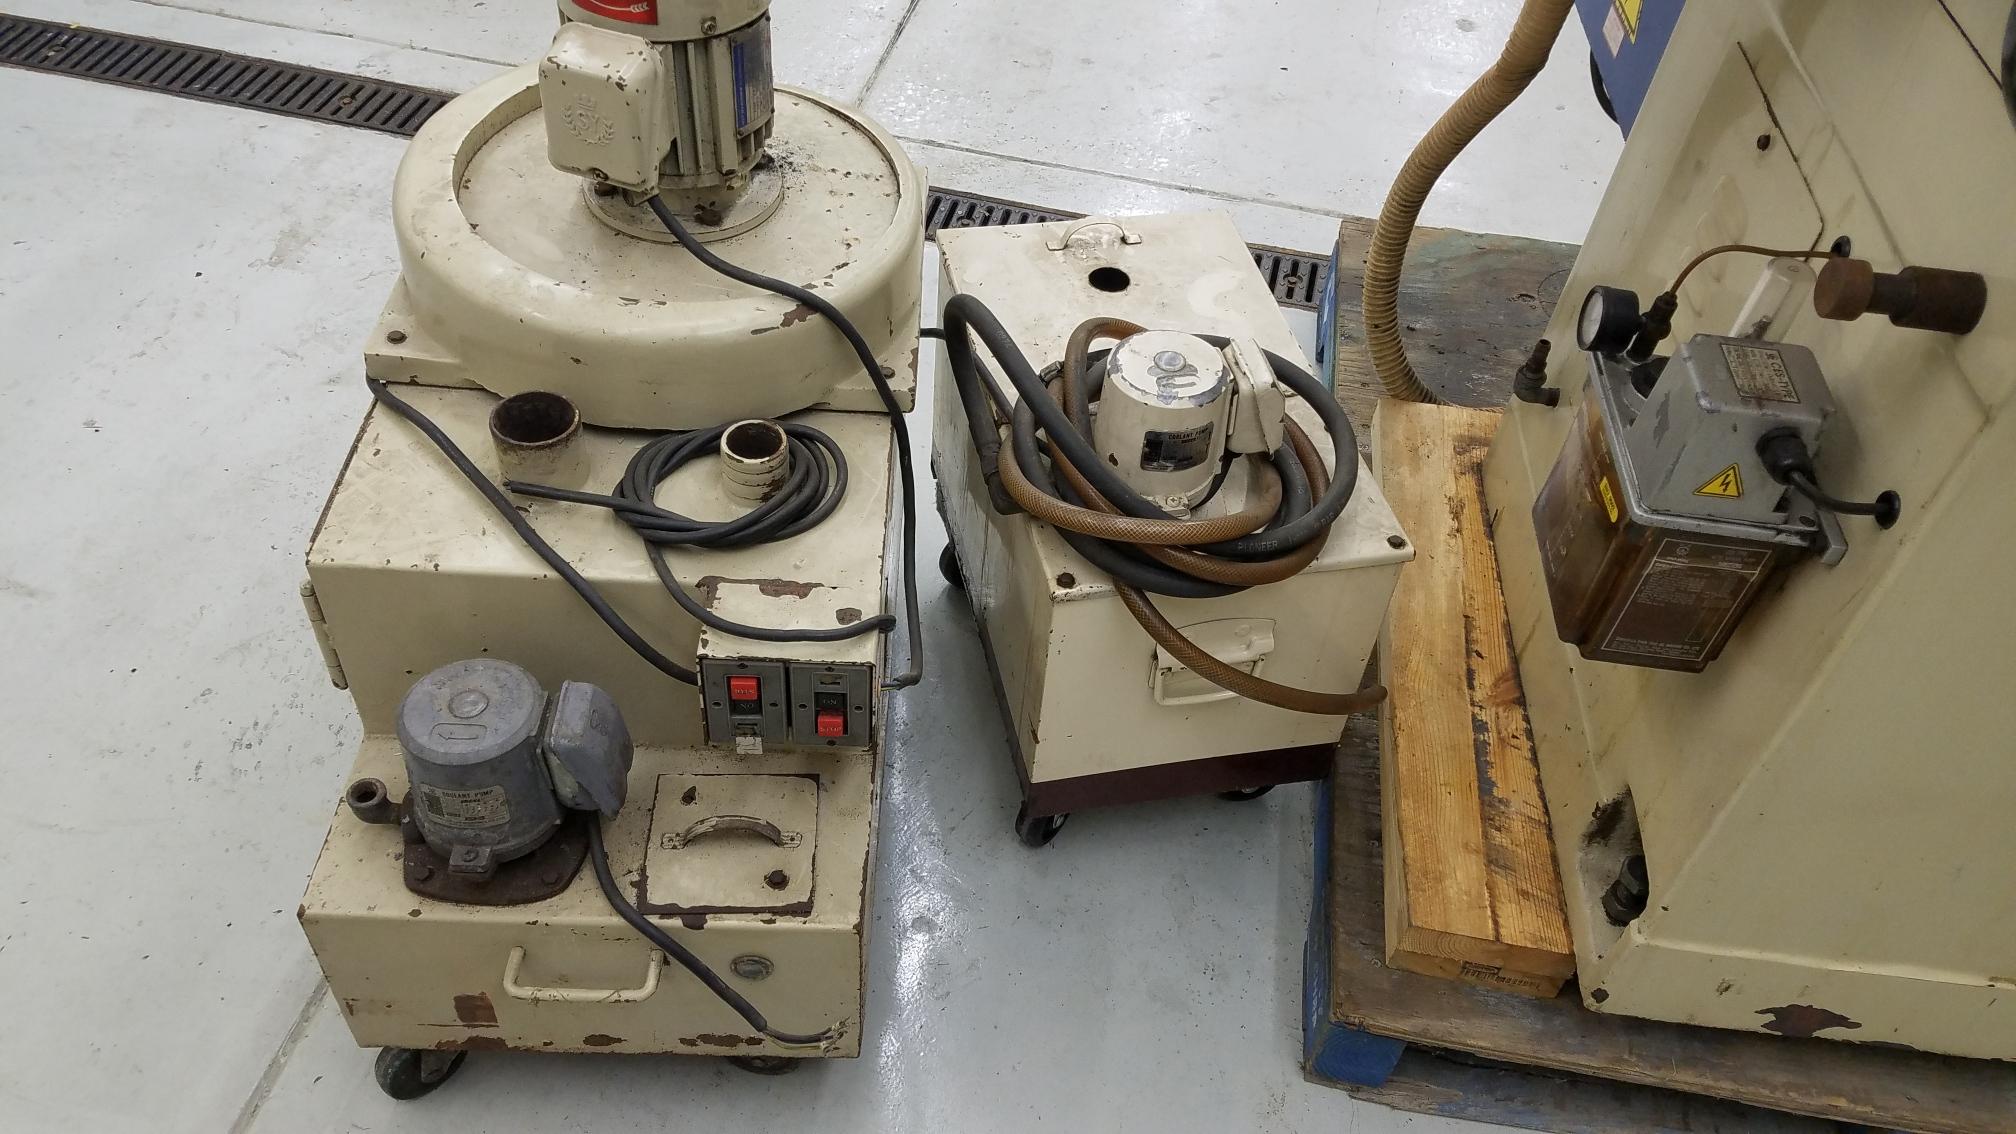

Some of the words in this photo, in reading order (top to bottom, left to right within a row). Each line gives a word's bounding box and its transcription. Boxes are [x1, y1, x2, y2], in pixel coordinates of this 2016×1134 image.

[1168, 432, 1193, 440] COOLANT
[1238, 540, 1278, 553] PIONEER
[474, 789, 494, 797] PUMP
